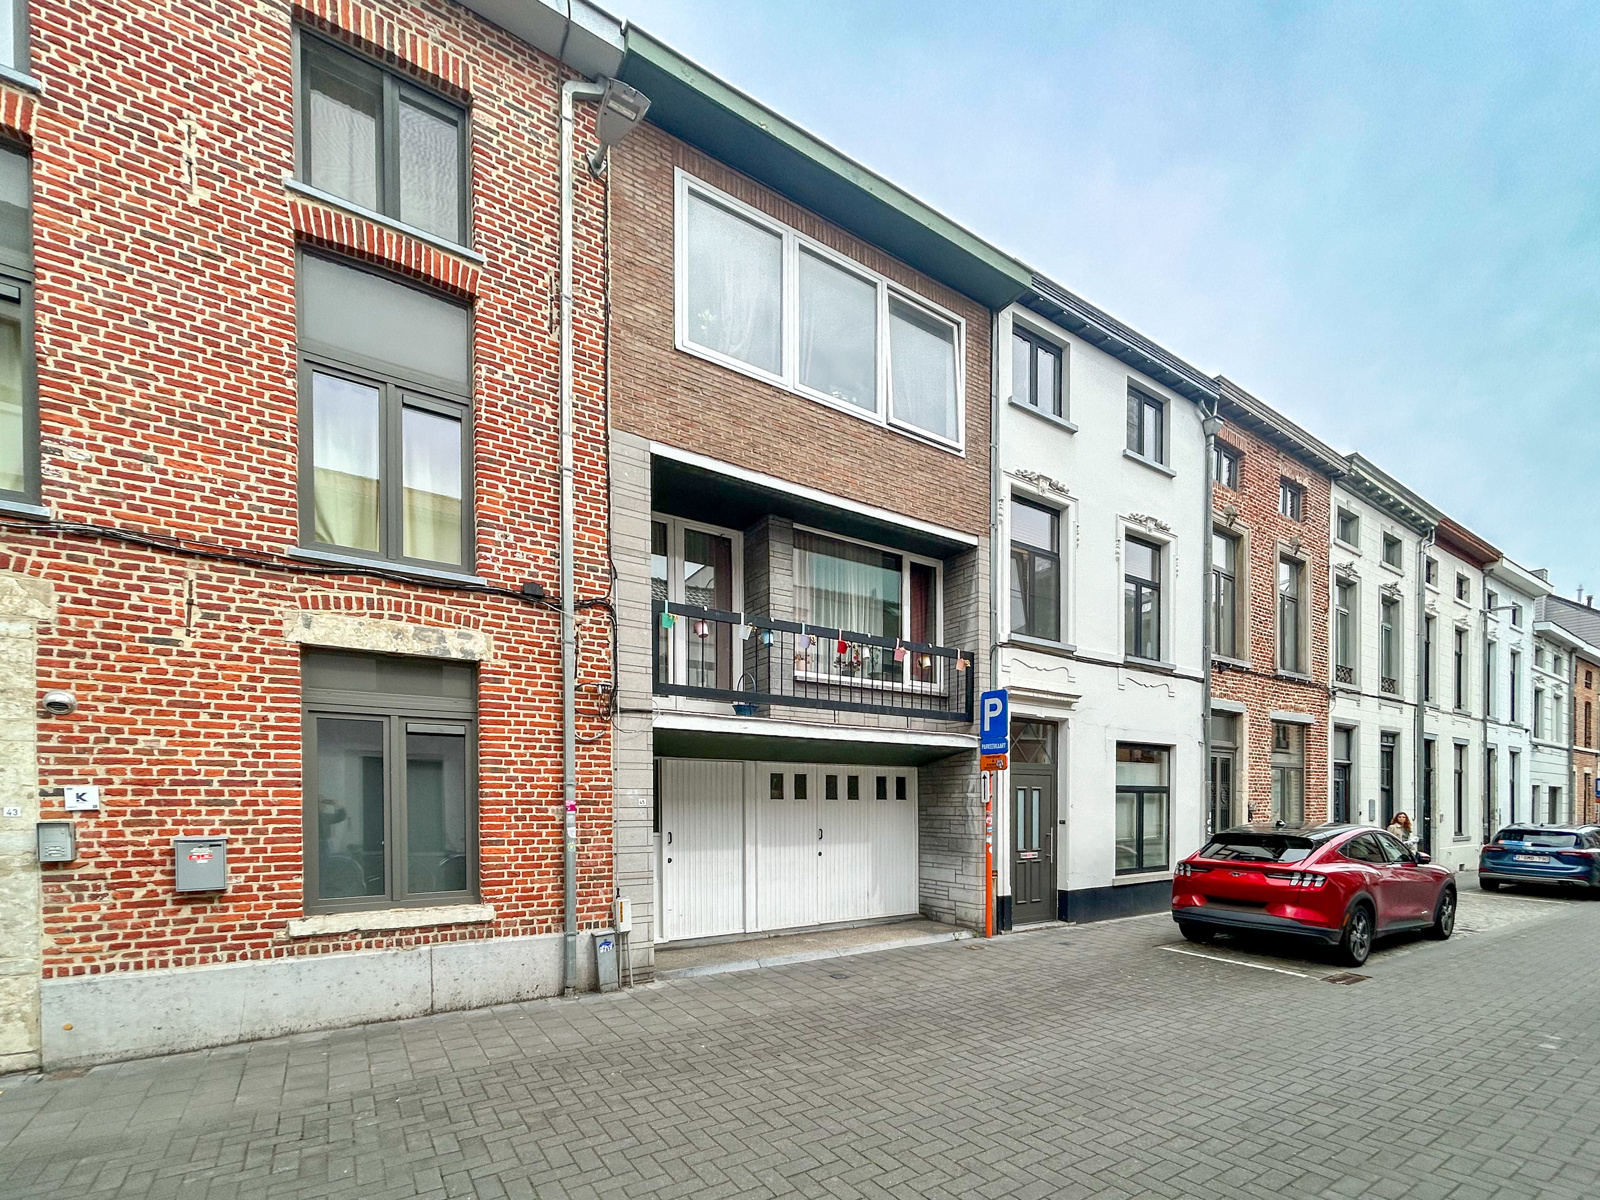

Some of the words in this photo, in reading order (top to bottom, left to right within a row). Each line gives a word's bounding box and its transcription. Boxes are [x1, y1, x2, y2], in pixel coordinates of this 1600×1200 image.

[983, 697, 1003, 732] P
[76, 792, 88, 802] K
[6, 808, 18, 816] 43
